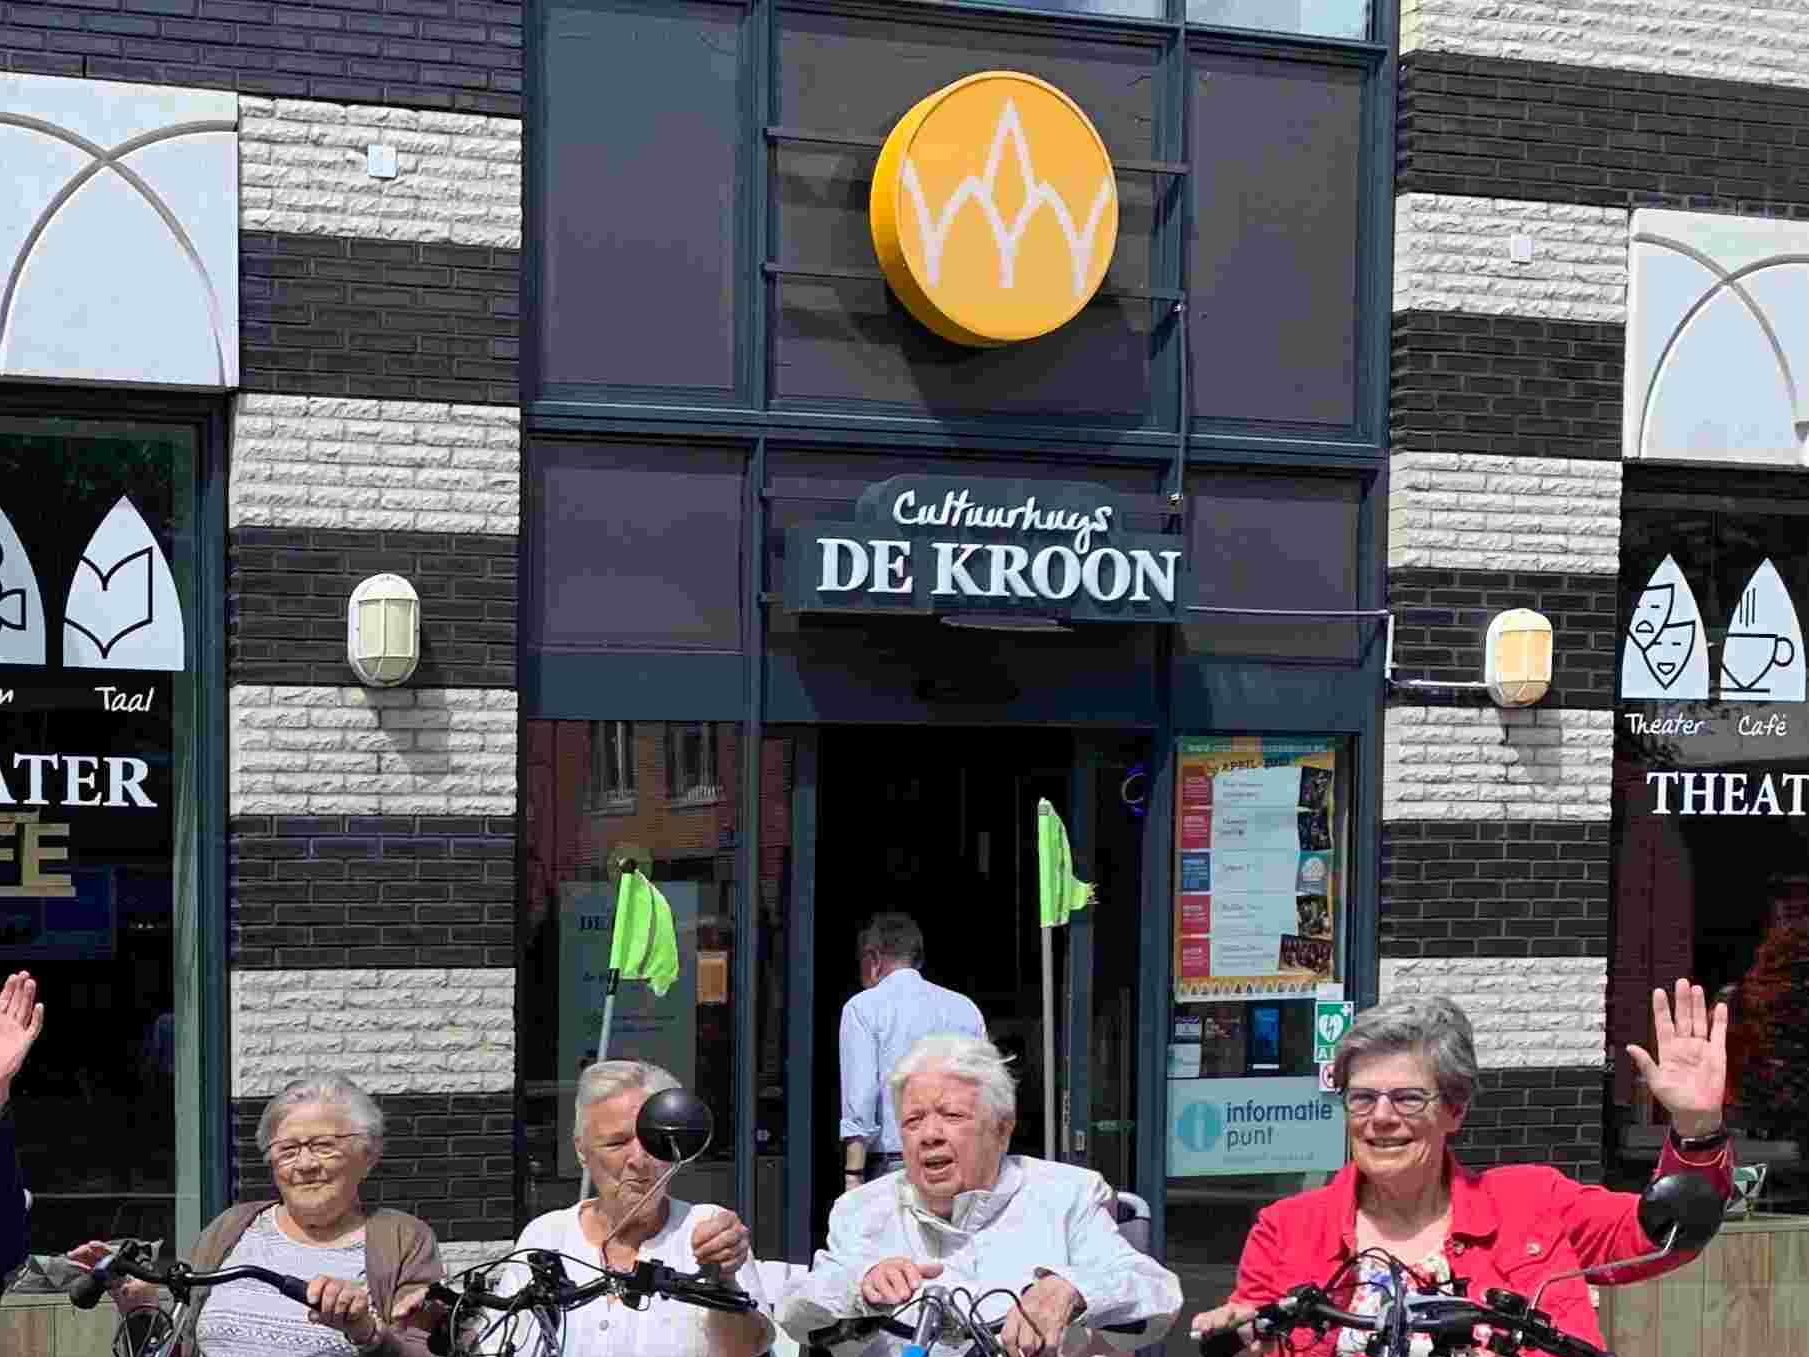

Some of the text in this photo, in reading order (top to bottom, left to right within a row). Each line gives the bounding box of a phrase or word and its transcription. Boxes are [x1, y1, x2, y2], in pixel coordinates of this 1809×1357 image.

[816, 538, 1181, 602] DE KROON
[94, 686, 155, 713] Taal
[1624, 711, 1705, 736] Theater
[1226, 1099, 1333, 1123] informatie
[1226, 1126, 1273, 1153] punt
